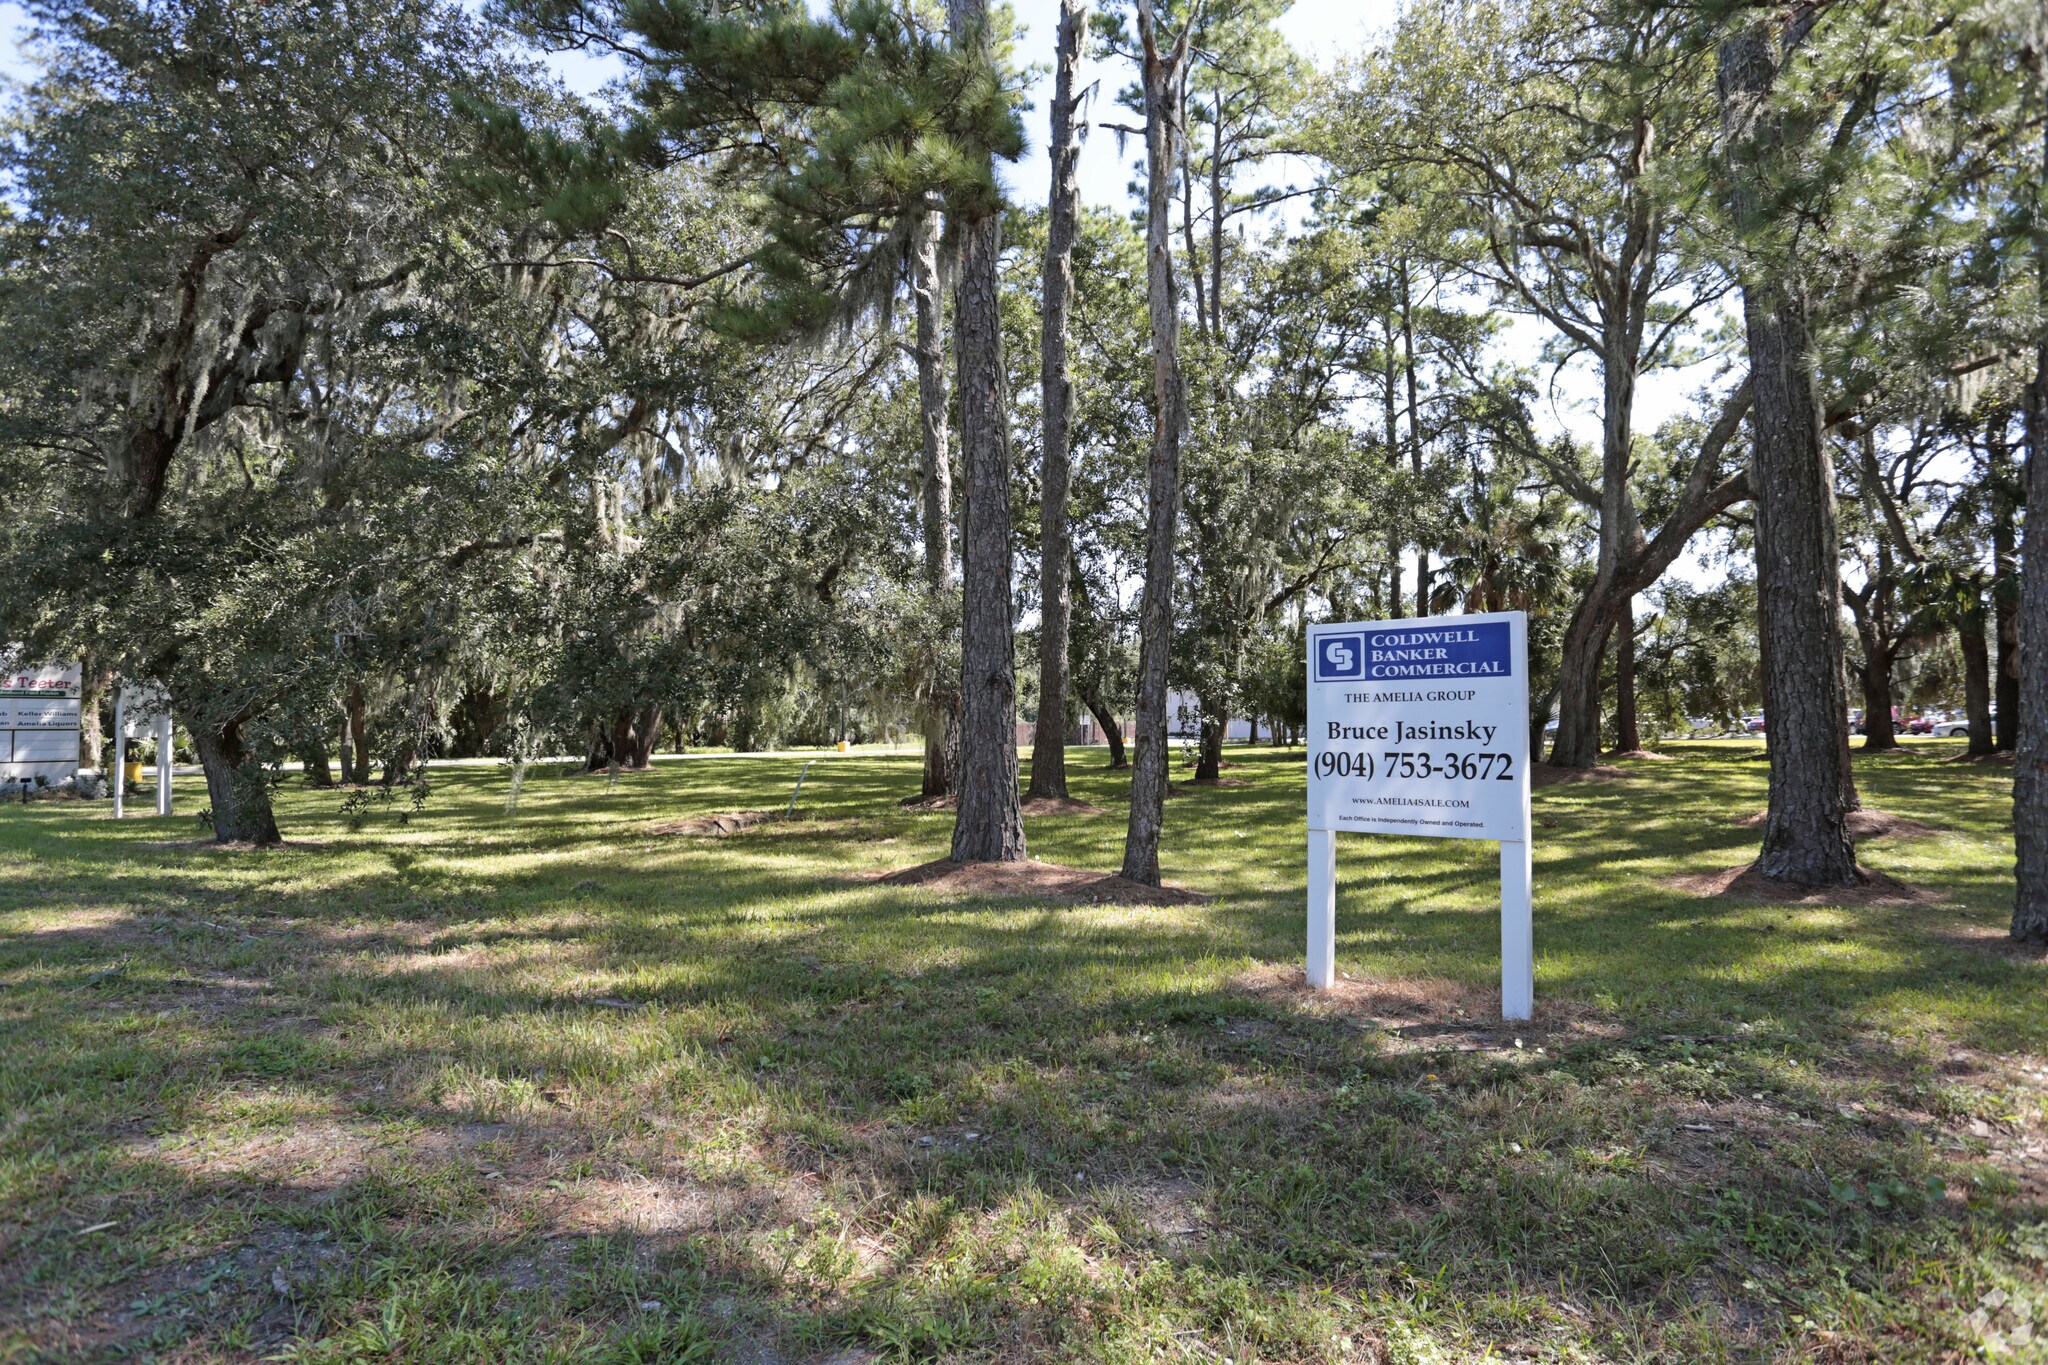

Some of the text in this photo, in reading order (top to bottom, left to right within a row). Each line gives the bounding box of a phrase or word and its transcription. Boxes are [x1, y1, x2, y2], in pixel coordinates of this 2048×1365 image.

[1370, 630, 1480, 647] COLDWELL
[1371, 648, 1448, 662] BANKER
[1371, 661, 1505, 677] COMMERCIAL
[17, 676, 71, 689] Teeter
[1344, 690, 1476, 703] THE AMELIA GROUP
[1327, 720, 1497, 746] Bruce Jasinsky
[1314, 751, 1514, 782] (904) 753-3672
[1352, 797, 1470, 809] www.AMELIA4SALE.COM
[1377, 817, 1418, 825] Independently
[1454, 821, 1485, 829] Operated.
